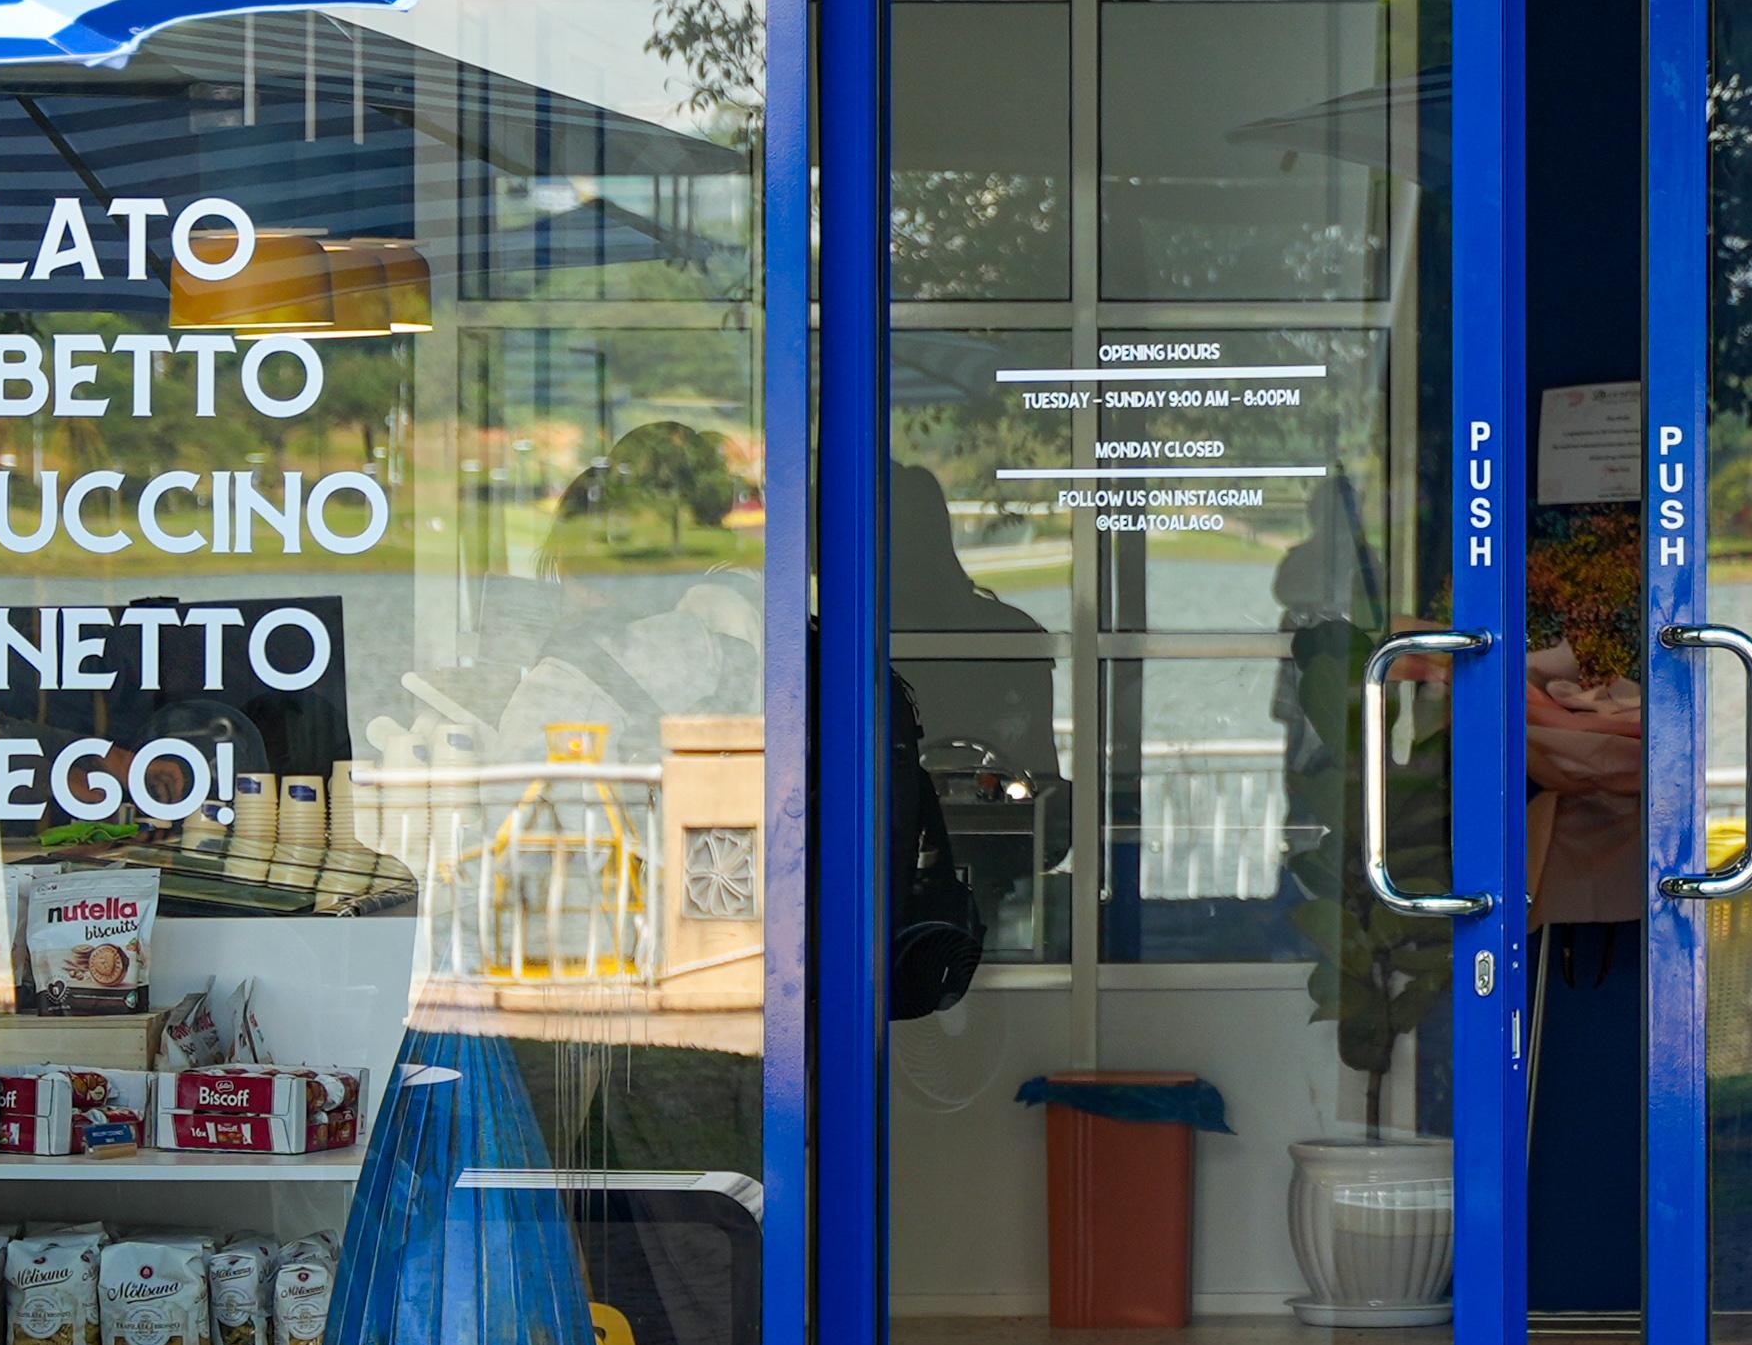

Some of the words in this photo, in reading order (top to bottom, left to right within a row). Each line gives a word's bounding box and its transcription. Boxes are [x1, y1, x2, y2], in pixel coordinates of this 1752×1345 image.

[1098, 343, 1166, 362] OPENING
[1167, 342, 1221, 361] HOURS
[1022, 390, 1091, 410] TUESDAY
[1105, 389, 1169, 409] SUNDAY
[1168, 390, 1202, 408] 9:00
[1204, 389, 1230, 407] AM
[1243, 389, 1301, 408] 8:00PM
[1095, 440, 1162, 459] MONDAY
[1164, 440, 1225, 458] CLOSED
[1058, 489, 1125, 508] FOLLOW
[1126, 490, 1147, 507] US
[1148, 489, 1174, 507] ON
[1174, 488, 1263, 507] INSTAGRAM
[1470, 421, 1492, 567] PUSH
[1659, 425, 1685, 567] PUSH
[1095, 513, 1225, 532] @GELATOALAGO
[47, 897, 139, 923] nutella
[84, 919, 140, 942] biscuits
[199, 1086, 250, 1107] Biscoff
[106, 1280, 184, 1304] Molisana
